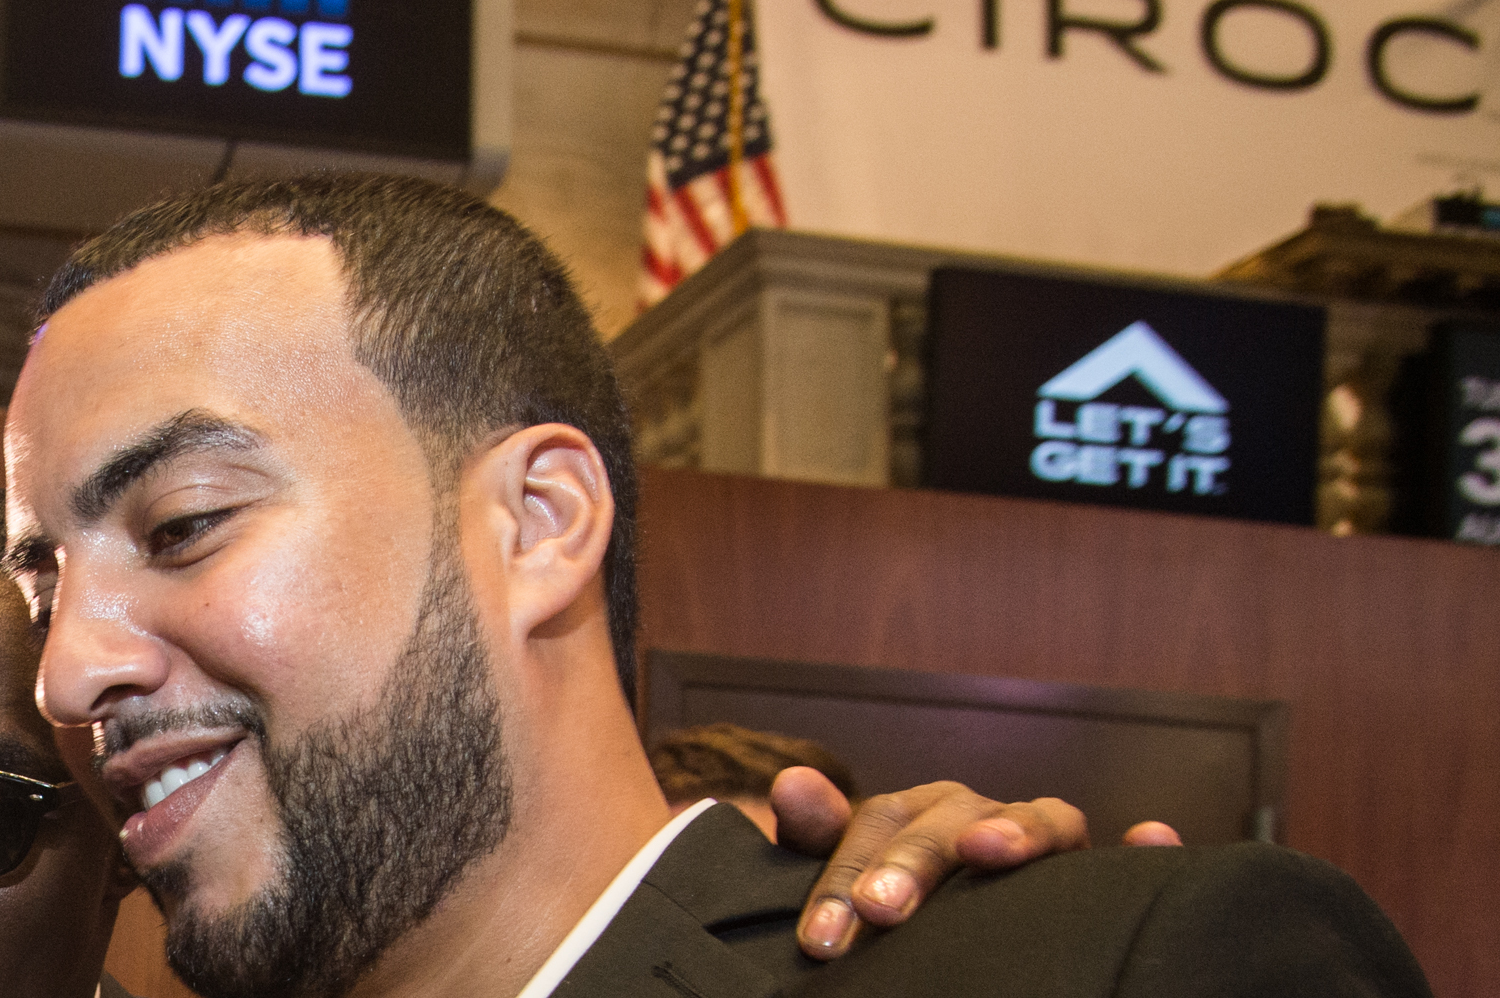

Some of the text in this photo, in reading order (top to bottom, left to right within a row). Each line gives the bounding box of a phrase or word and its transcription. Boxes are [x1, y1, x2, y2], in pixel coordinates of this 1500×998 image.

[119, 3, 353, 98] NYSE
[1033, 399, 1231, 454] LET'S
[1030, 440, 1231, 495] GET IT
